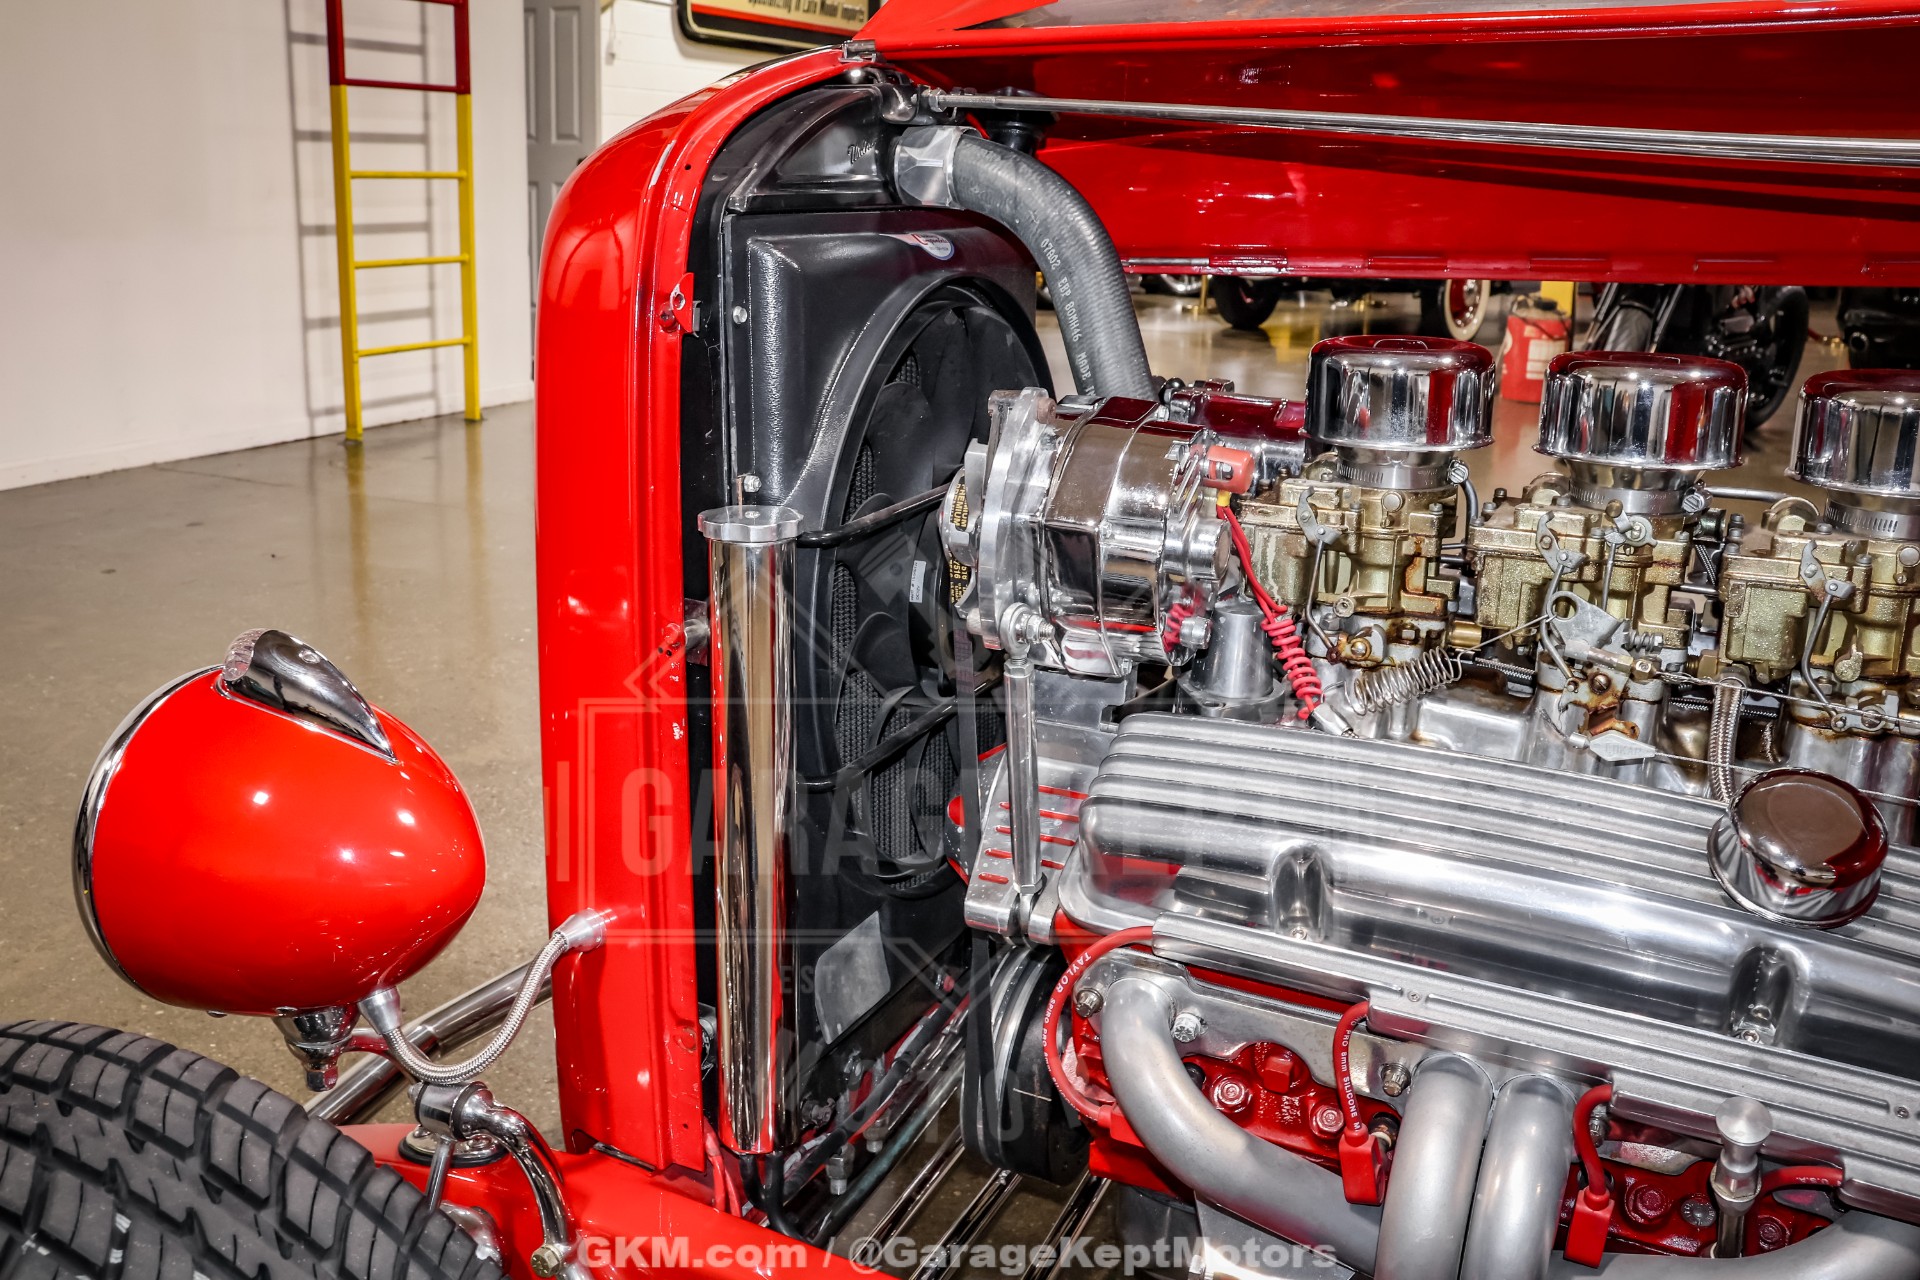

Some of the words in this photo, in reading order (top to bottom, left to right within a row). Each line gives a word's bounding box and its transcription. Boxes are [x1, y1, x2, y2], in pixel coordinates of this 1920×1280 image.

[1077, 351, 1091, 380] MADE
[1056, 952, 1092, 993] TAYLOR
[1044, 998, 1056, 1024] SPIRO
[1343, 1076, 1358, 1118] SILICONE
